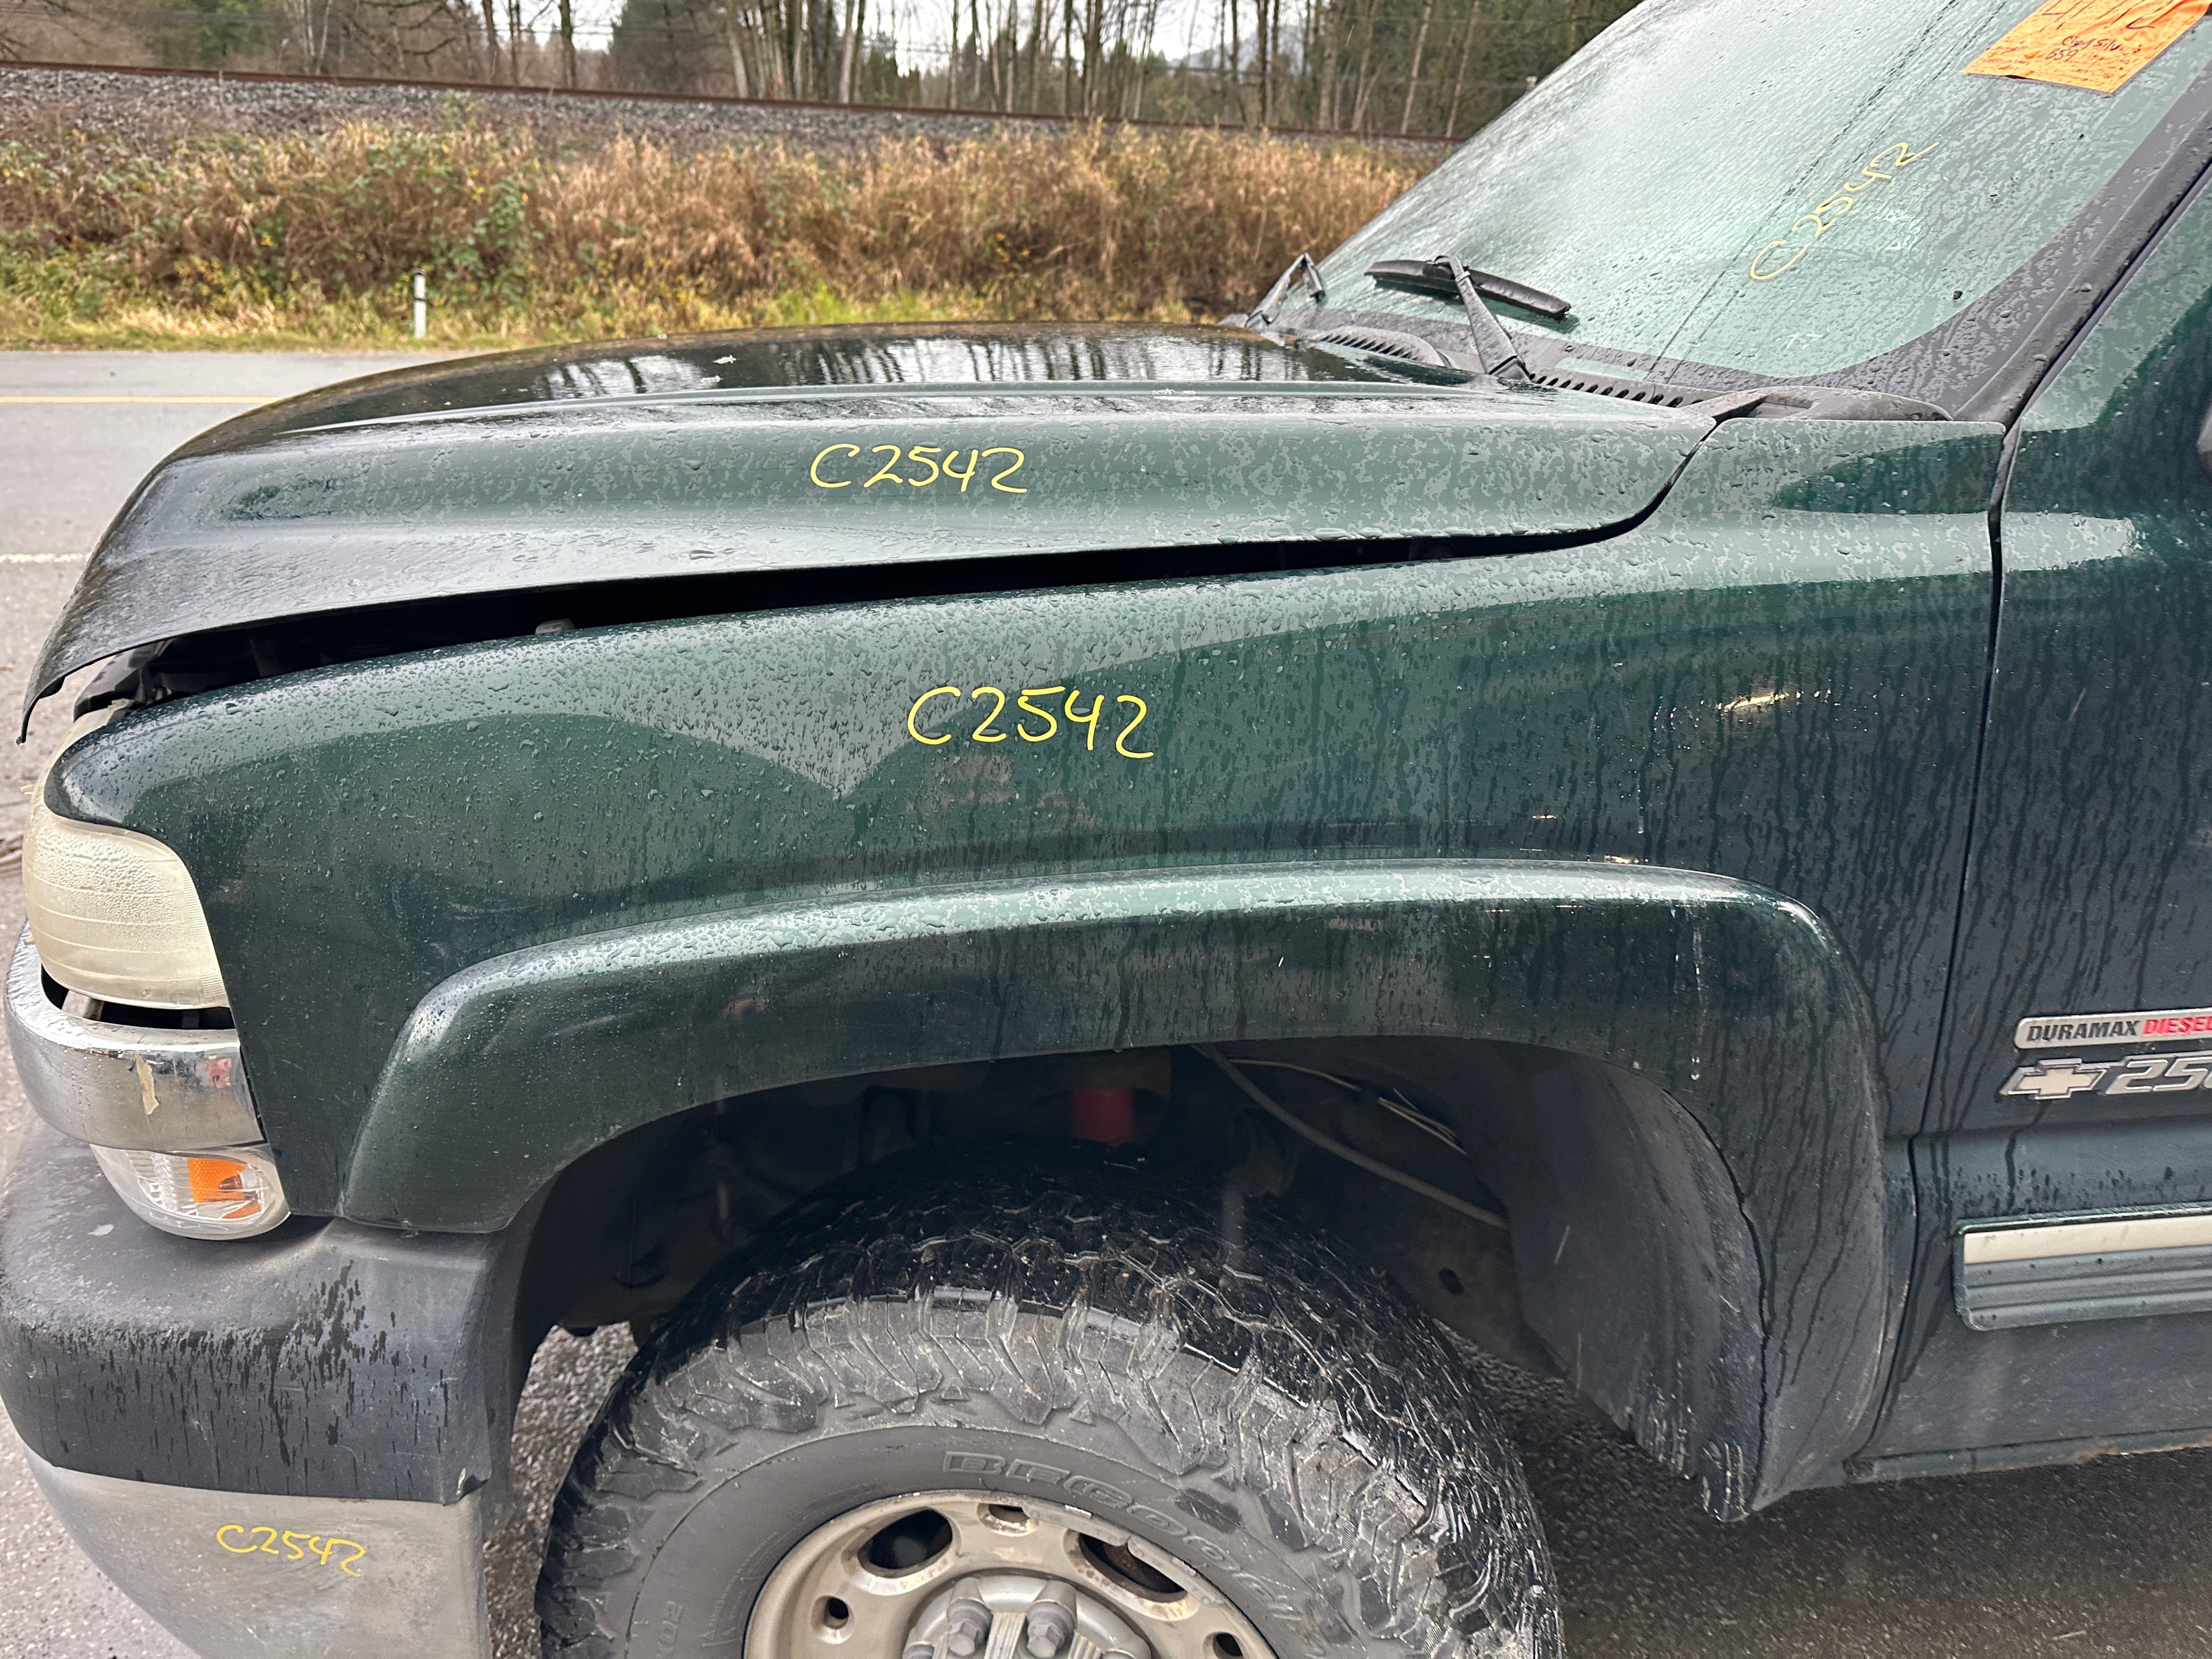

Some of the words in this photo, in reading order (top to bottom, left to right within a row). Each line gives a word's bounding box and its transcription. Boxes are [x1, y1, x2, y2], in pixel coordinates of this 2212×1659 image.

[1749, 141, 1940, 281] C2542
[810, 443, 1028, 493] C2542
[907, 686, 1154, 759] C2542
[2027, 1020, 2141, 1043] DURAMAX
[2105, 1058, 2212, 1095] 25
[215, 1524, 366, 1577] C2542
